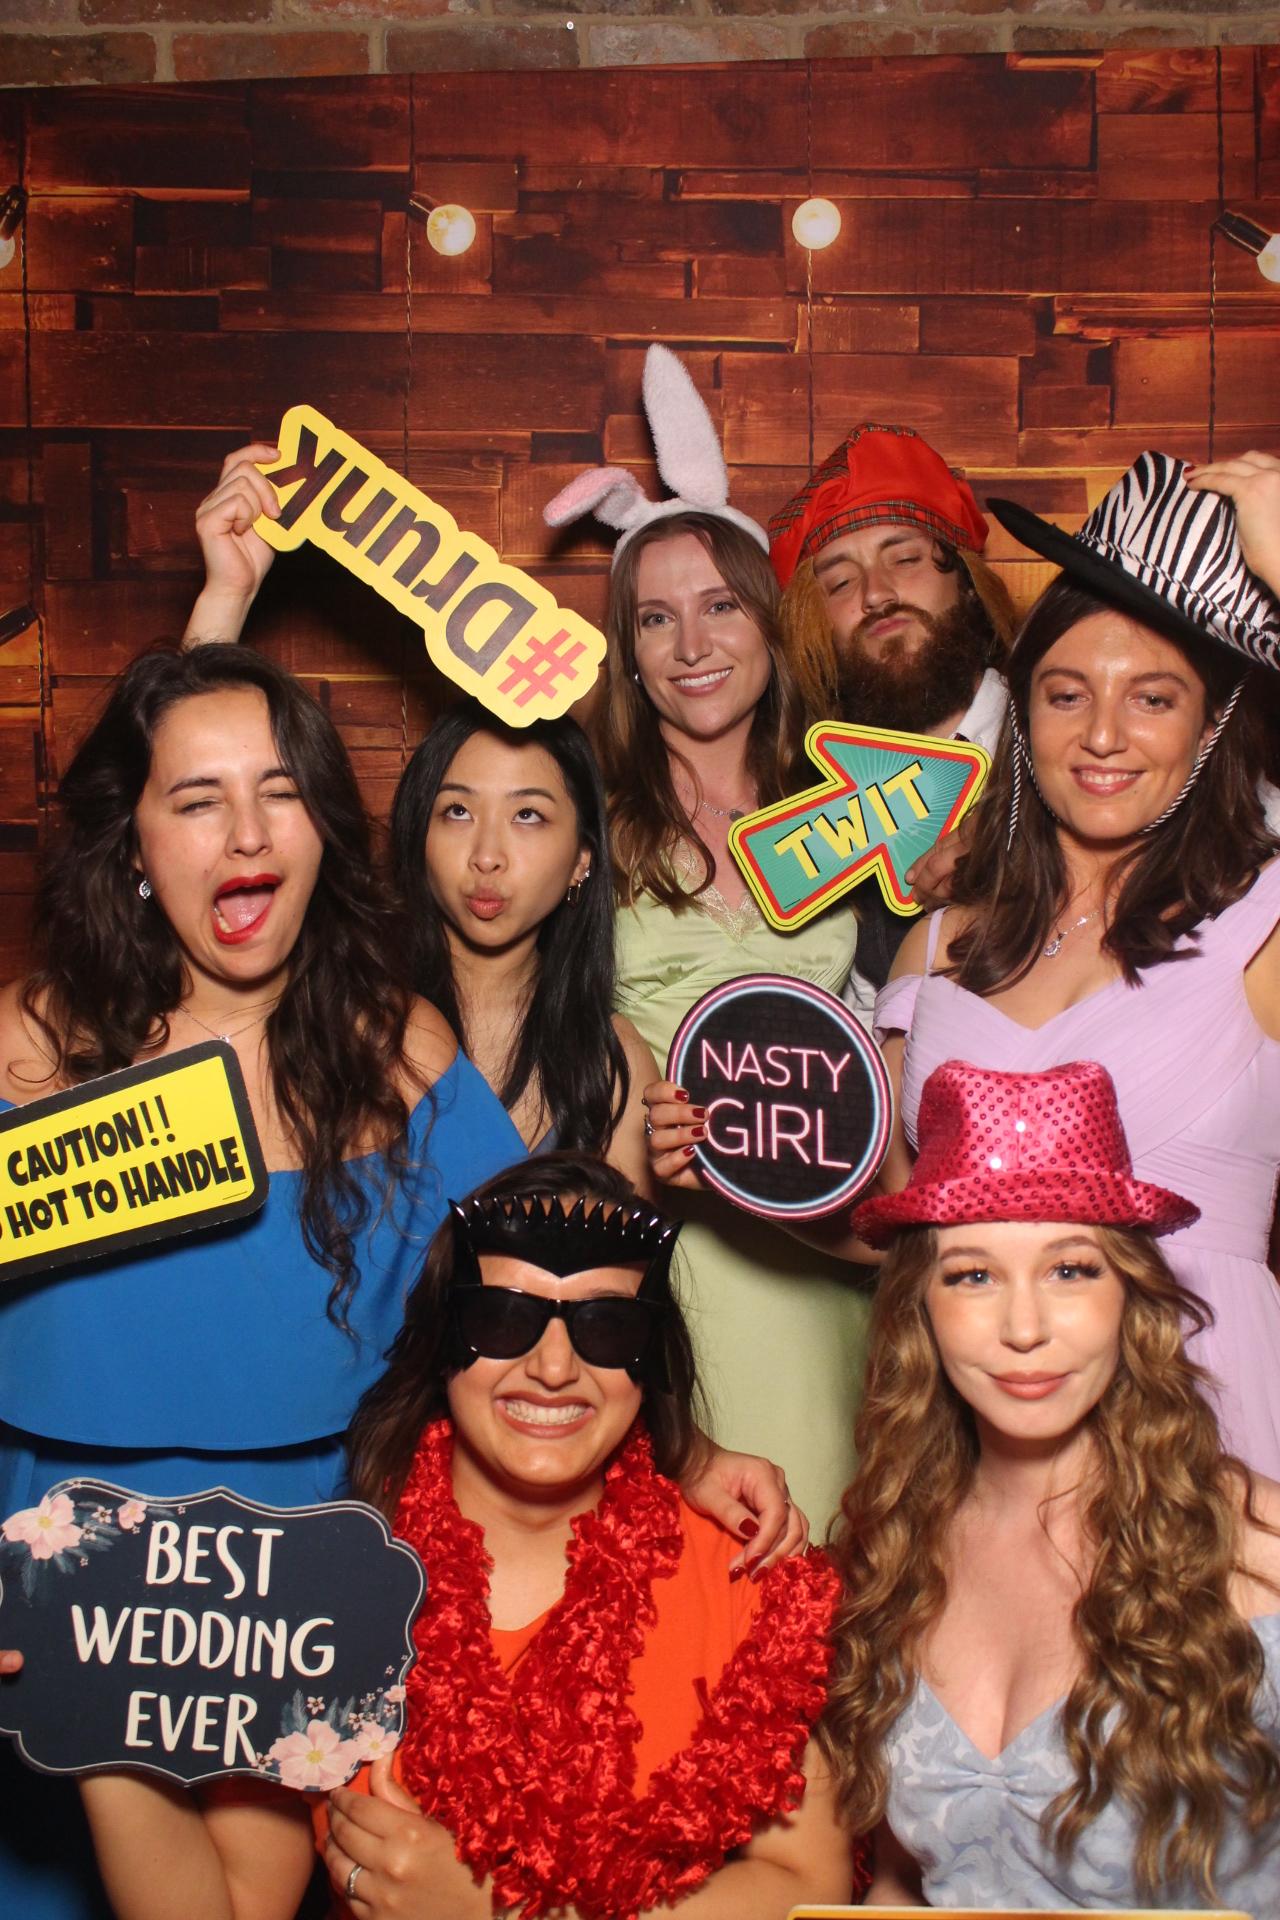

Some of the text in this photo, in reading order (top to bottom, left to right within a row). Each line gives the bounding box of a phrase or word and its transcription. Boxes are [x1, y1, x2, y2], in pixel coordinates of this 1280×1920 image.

[264, 424, 588, 708] #Drunk
[774, 760, 930, 880] TWIT
[702, 1039, 850, 1092] NASTY
[7, 1094, 176, 1186] CAUTION!!
[704, 1098, 851, 1168] GIRL
[5, 1189, 69, 1239] HOT
[72, 1179, 119, 1219] TO
[119, 1136, 247, 1209] HANDLE
[146, 1520, 284, 1600] BEST
[71, 1604, 335, 1679] WEDDING
[125, 1691, 258, 1766] EVER
